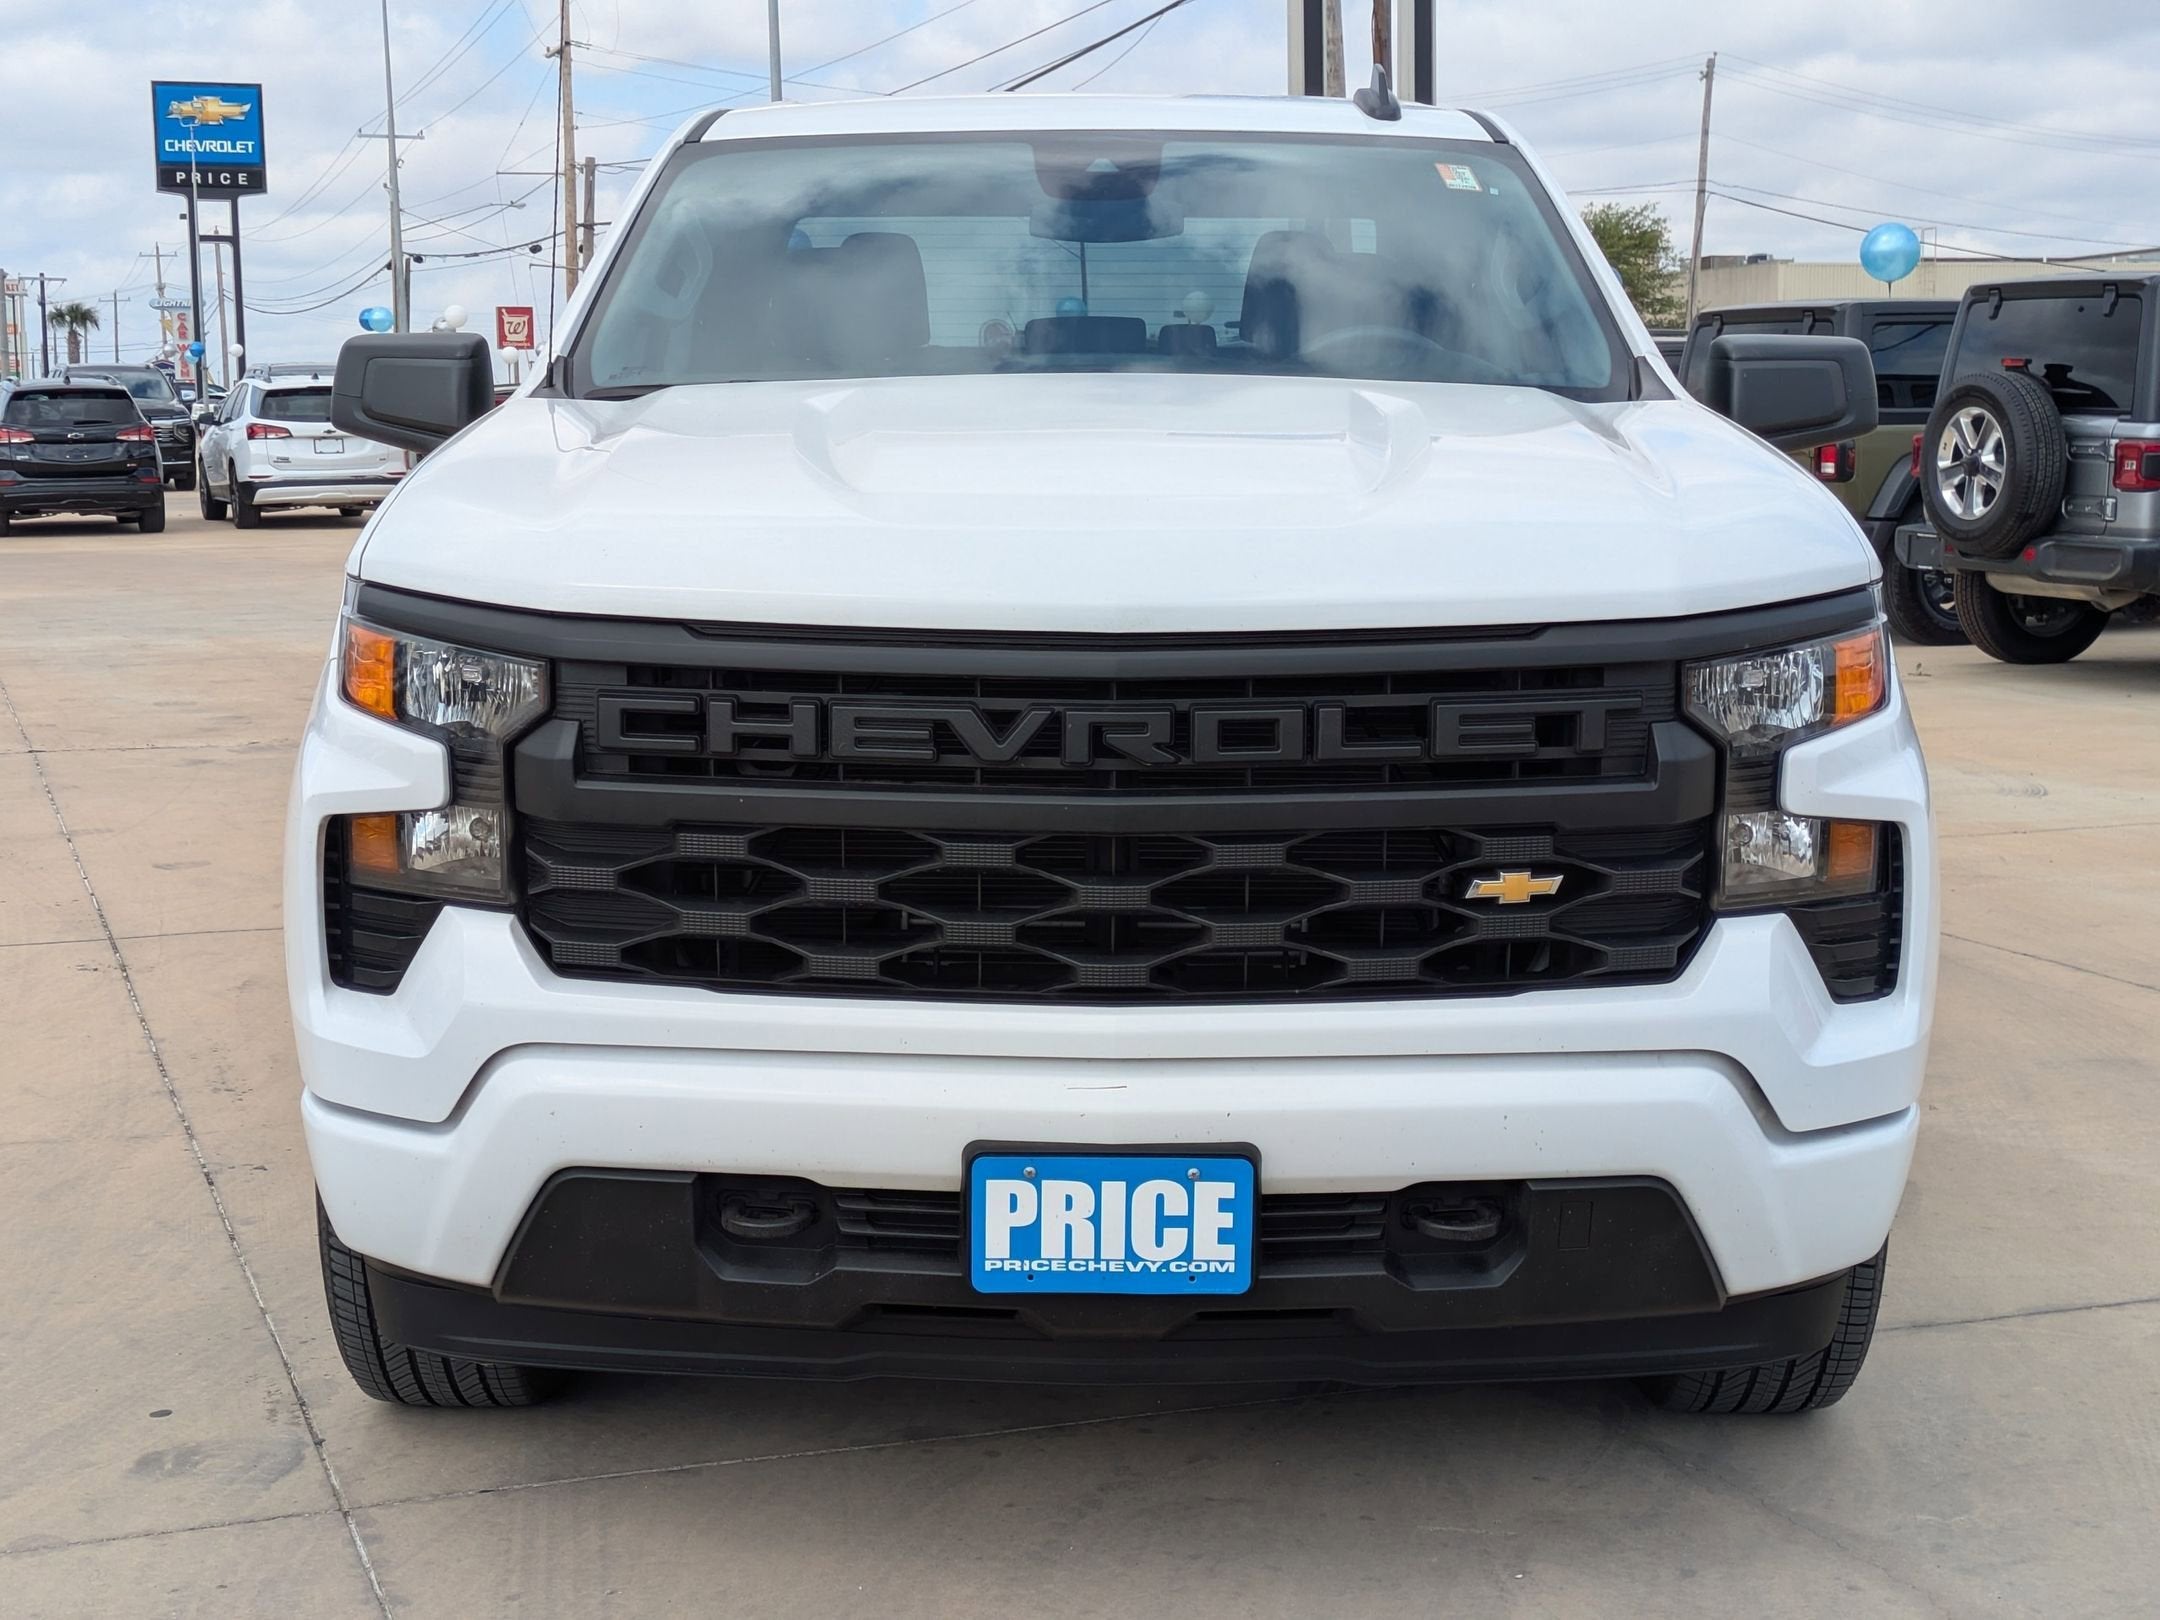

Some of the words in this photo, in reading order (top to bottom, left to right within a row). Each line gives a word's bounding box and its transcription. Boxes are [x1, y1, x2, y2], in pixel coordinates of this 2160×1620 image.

[164, 139, 255, 154] CHEVROLET
[176, 171, 248, 185] PRICE
[176, 312, 188, 339] CAR
[597, 695, 1643, 766] CHEVROLET
[985, 1179, 1236, 1262] PRICE
[984, 1259, 1236, 1274] PRICECHEVY.COM
